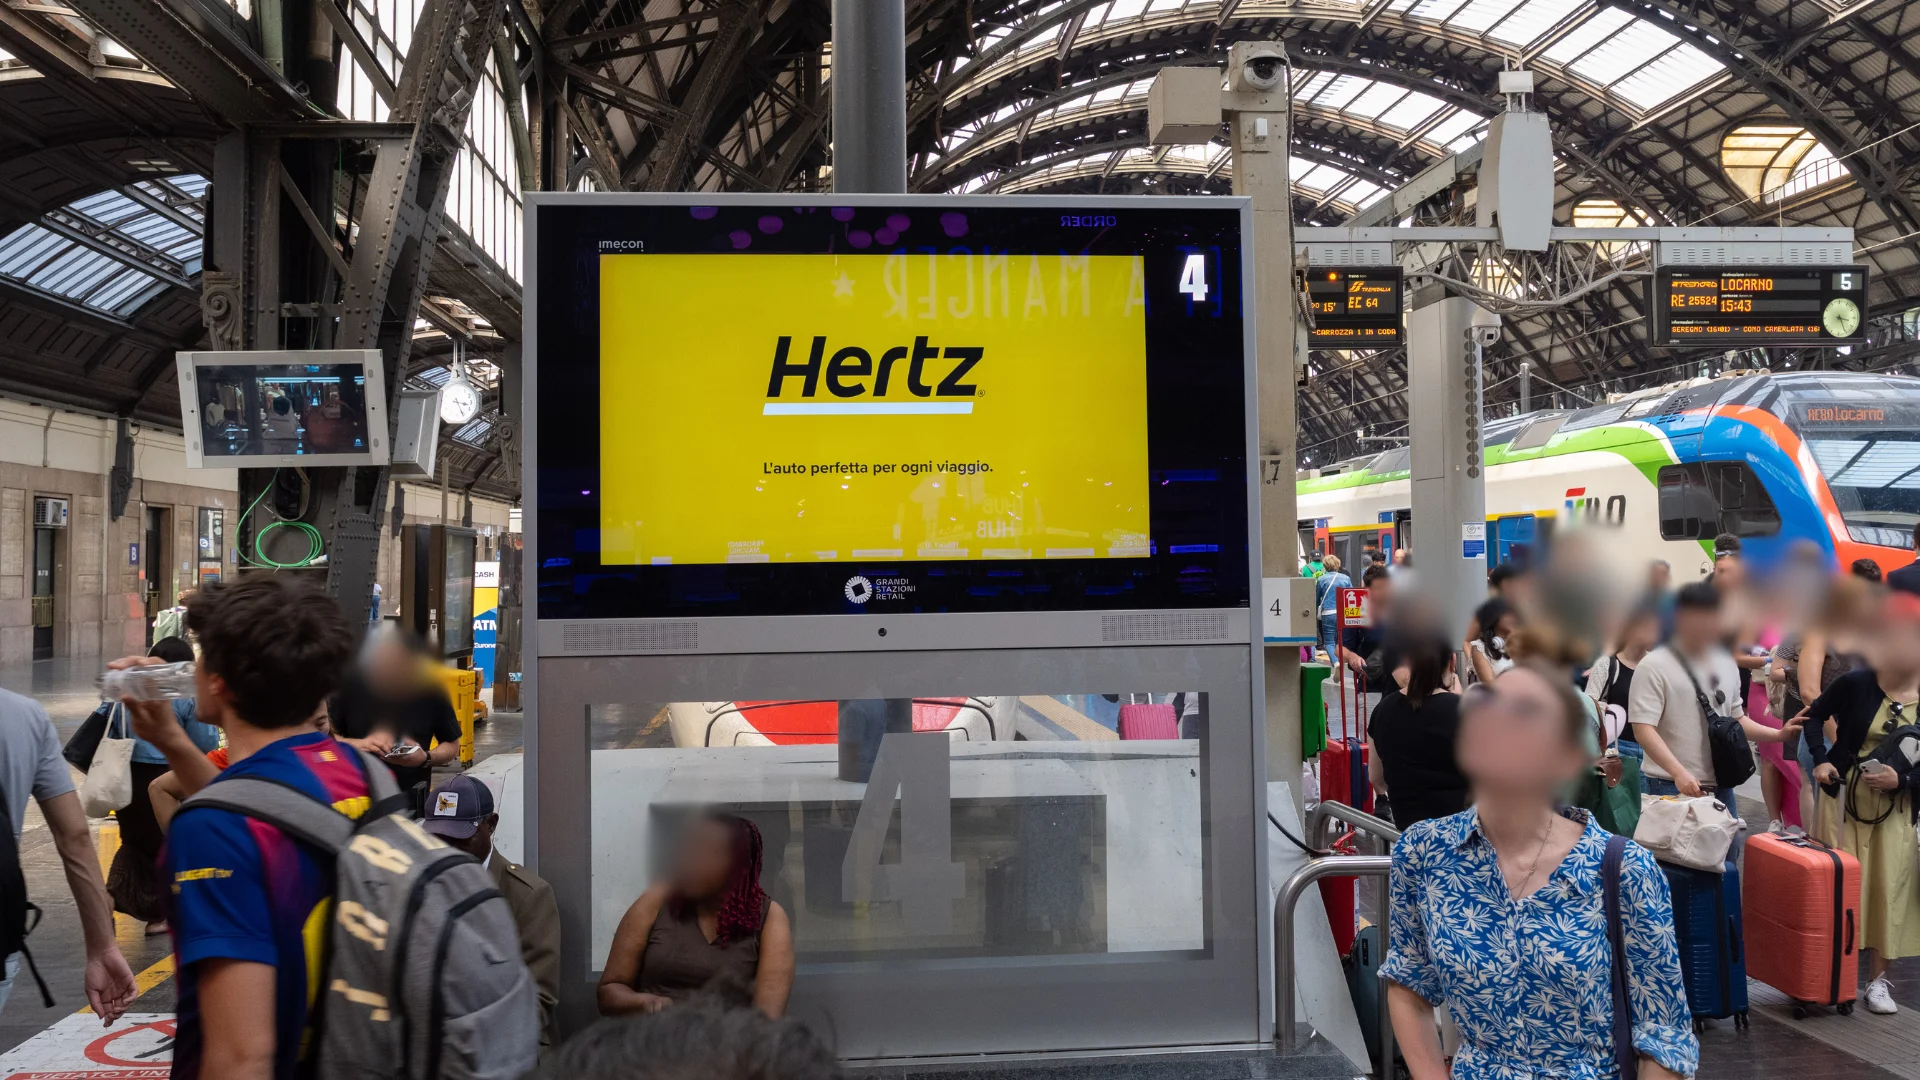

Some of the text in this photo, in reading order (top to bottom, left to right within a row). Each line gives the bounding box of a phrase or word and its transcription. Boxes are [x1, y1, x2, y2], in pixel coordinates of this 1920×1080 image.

[599, 240, 644, 250] imecon
[1179, 254, 1208, 301] 4
[1721, 279, 1772, 290] LOCARNO
[1840, 273, 1852, 290] 5
[1348, 297, 1378, 308] EC 64
[1671, 294, 1717, 306] RE 25524
[1721, 300, 1751, 312] 15:43
[766, 336, 984, 398] Hertz
[1835, 406, 1884, 420] Locarno
[763, 460, 993, 476] L'auto perfetta per ogni viaggio.
[131, 548, 137, 560] B
[1270, 598, 1281, 616] 4
[842, 732, 966, 936] 4
